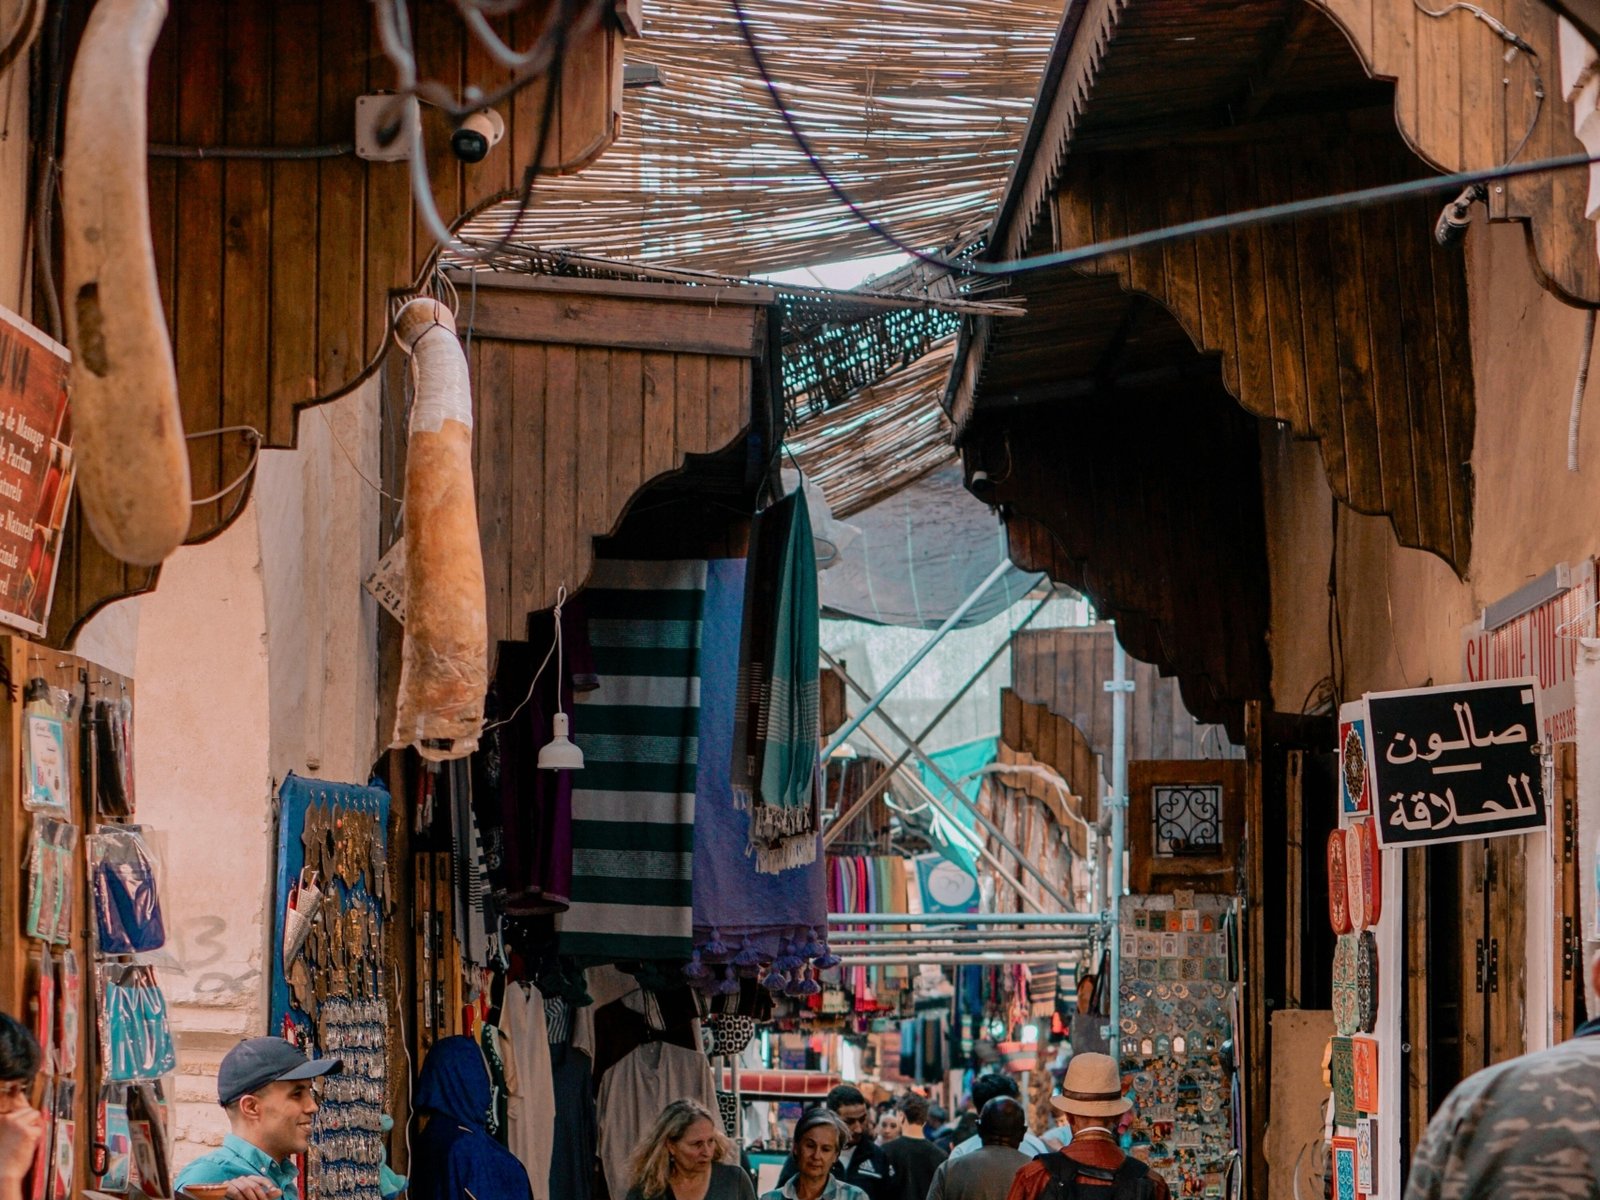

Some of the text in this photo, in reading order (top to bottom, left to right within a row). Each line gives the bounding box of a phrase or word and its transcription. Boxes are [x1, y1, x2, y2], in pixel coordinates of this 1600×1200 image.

[6, 407, 16, 431] de
[16, 413, 44, 454] Massage
[6, 443, 32, 475] Parfum
[0, 477, 22, 502] aturels
[5, 510, 34, 541] Naturels
[0, 545, 18, 568] cinale
[1386, 701, 1527, 764] صالون
[1389, 773, 1537, 831] للحلاقة
